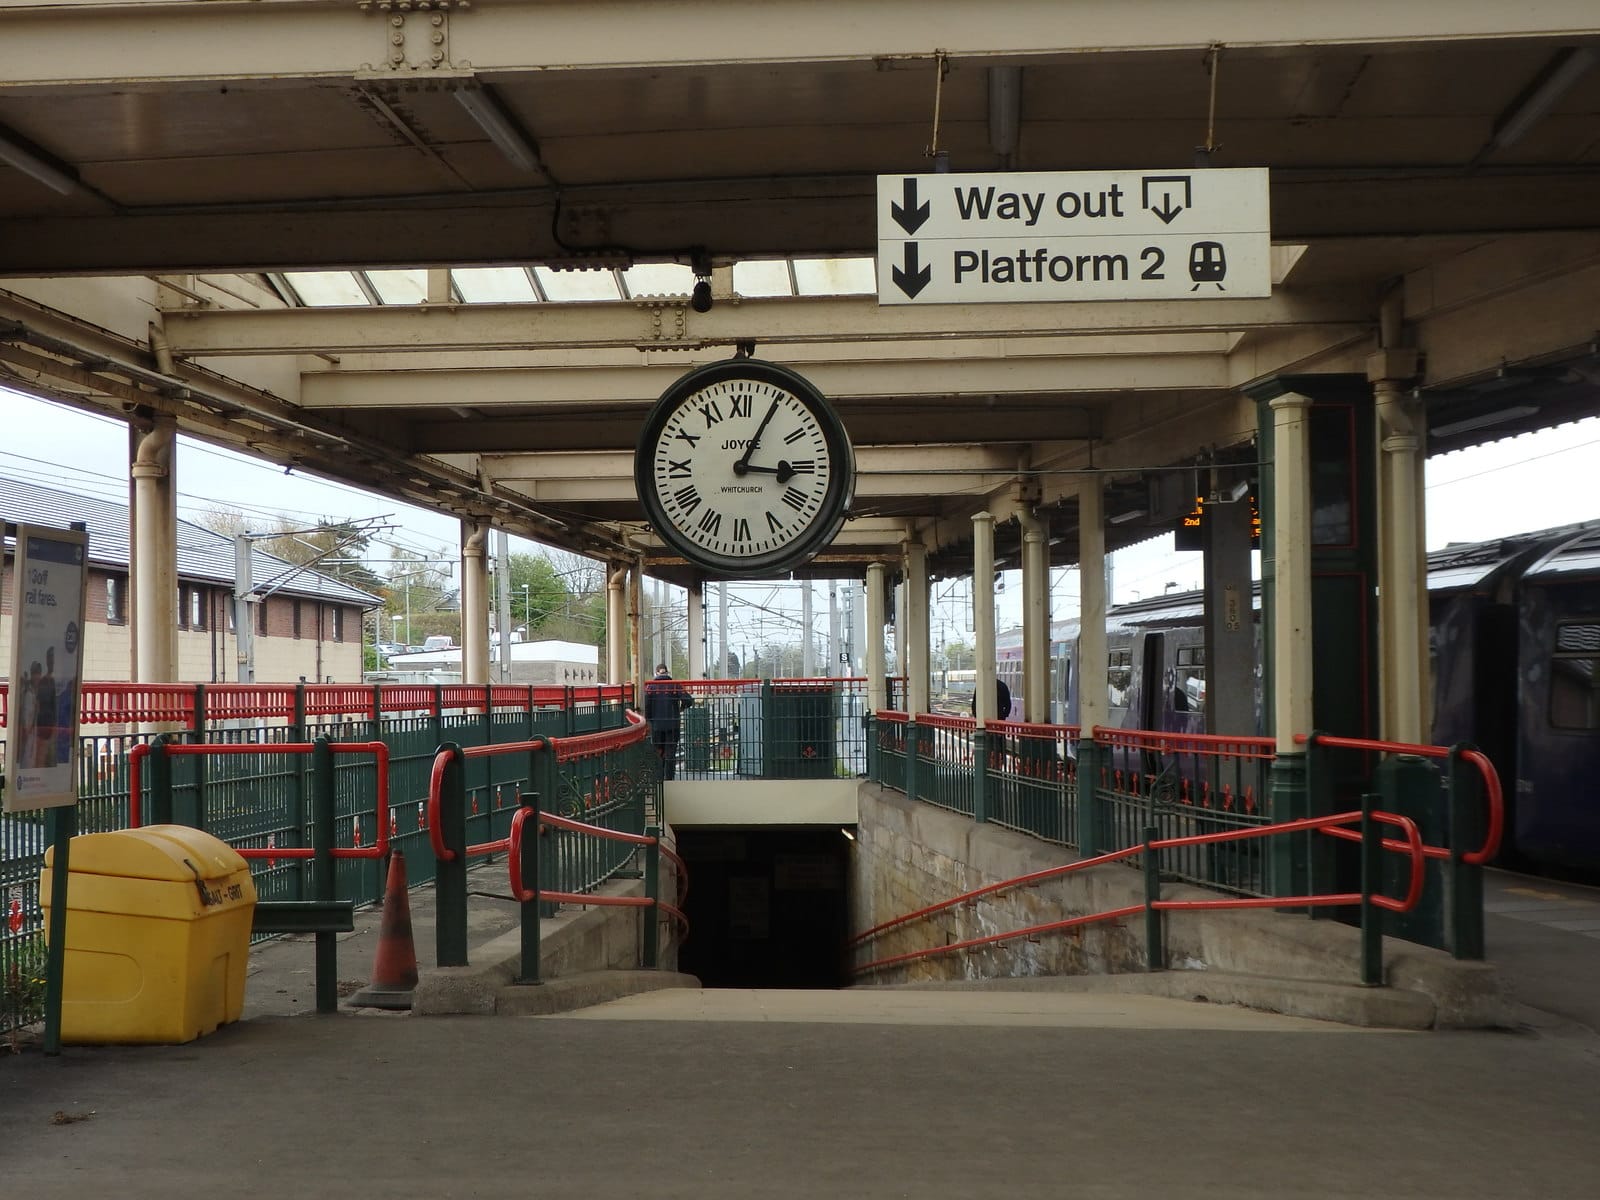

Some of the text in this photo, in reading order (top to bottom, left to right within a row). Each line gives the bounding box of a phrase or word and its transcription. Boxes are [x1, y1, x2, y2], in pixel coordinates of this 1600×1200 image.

[955, 184, 1124, 226] Way out
[955, 247, 1165, 284] Platform 2
[698, 400, 723, 429] XI
[729, 395, 752, 418] XII
[675, 428, 701, 449] X
[721, 439, 761, 450] JOYCE
[720, 486, 763, 494] WHITCHURCH
[1184, 517, 1200, 527] 2nd
